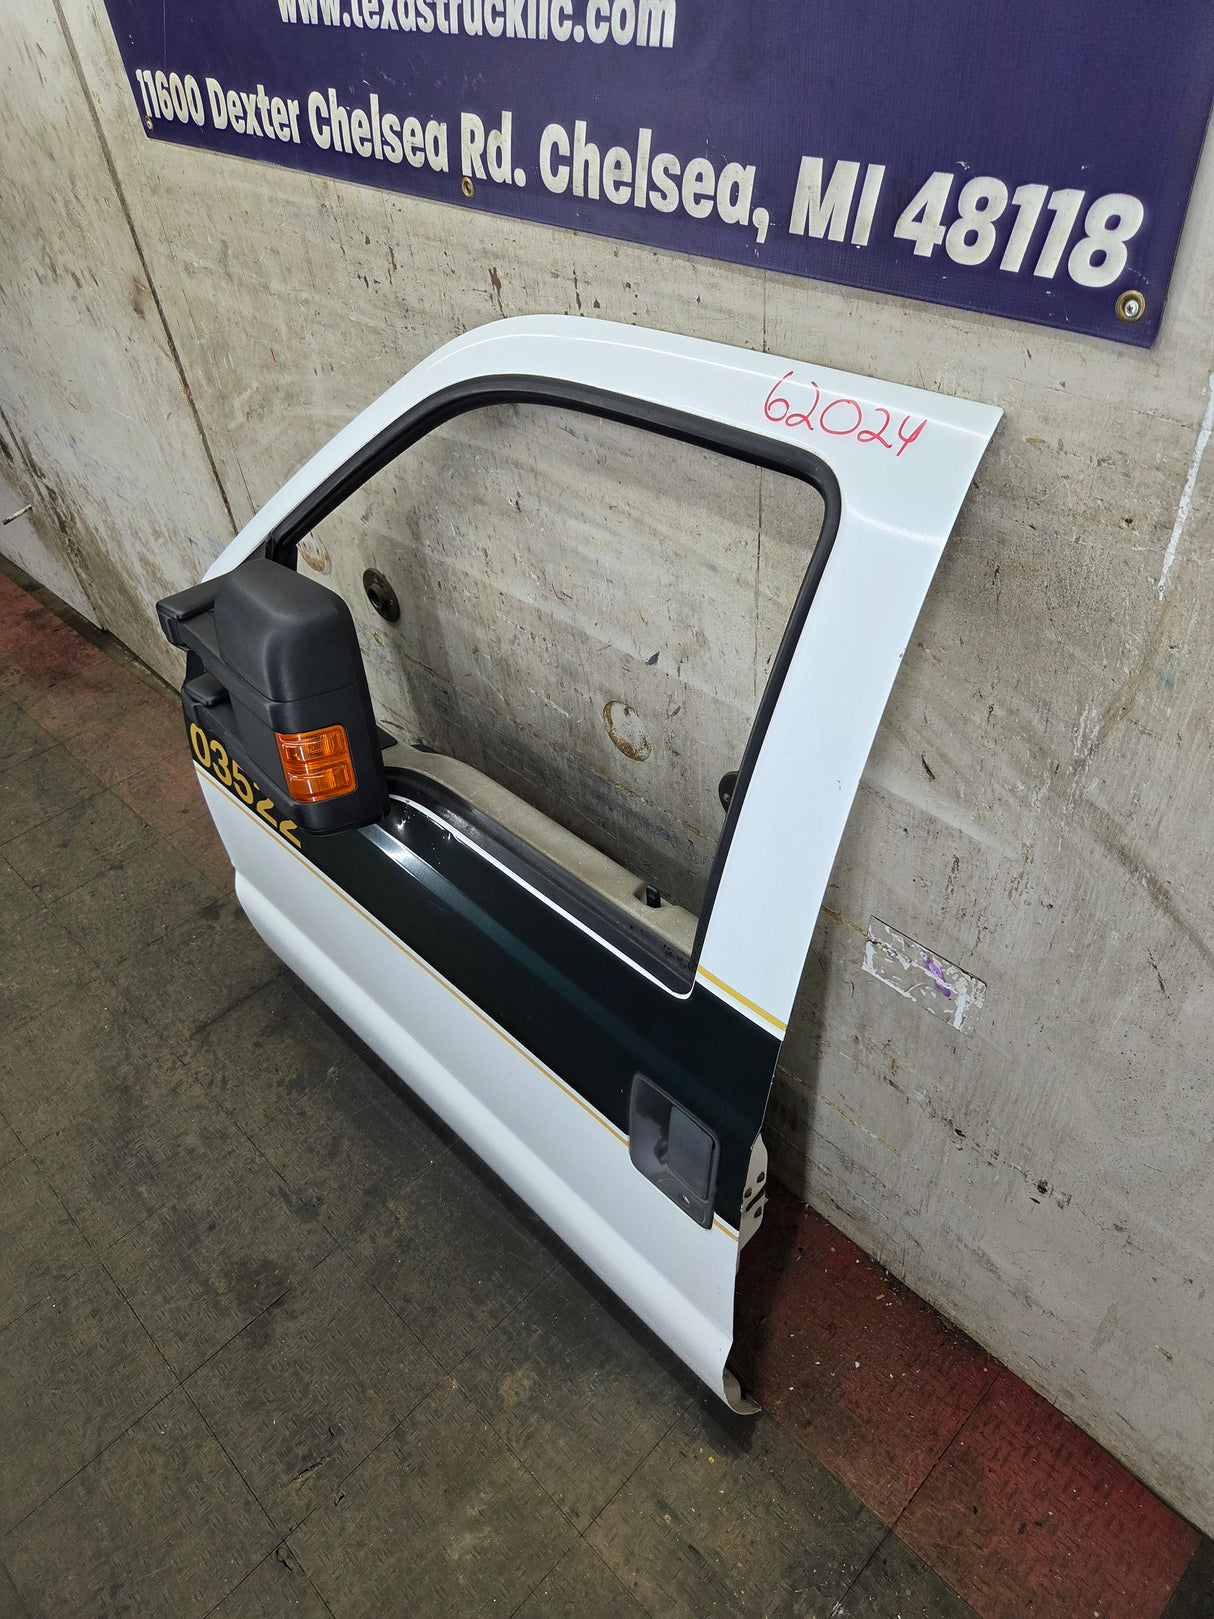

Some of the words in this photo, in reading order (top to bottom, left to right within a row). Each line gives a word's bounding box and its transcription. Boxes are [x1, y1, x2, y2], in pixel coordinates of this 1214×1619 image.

[136, 69, 204, 127] 11600
[205, 77, 301, 144] Dexter
[307, 88, 449, 173] Chelsea
[460, 111, 527, 188] Rd.
[539, 119, 769, 244] Chelsea,
[789, 155, 886, 247] MI
[893, 172, 1145, 288] 48118
[764, 371, 928, 457] 62024
